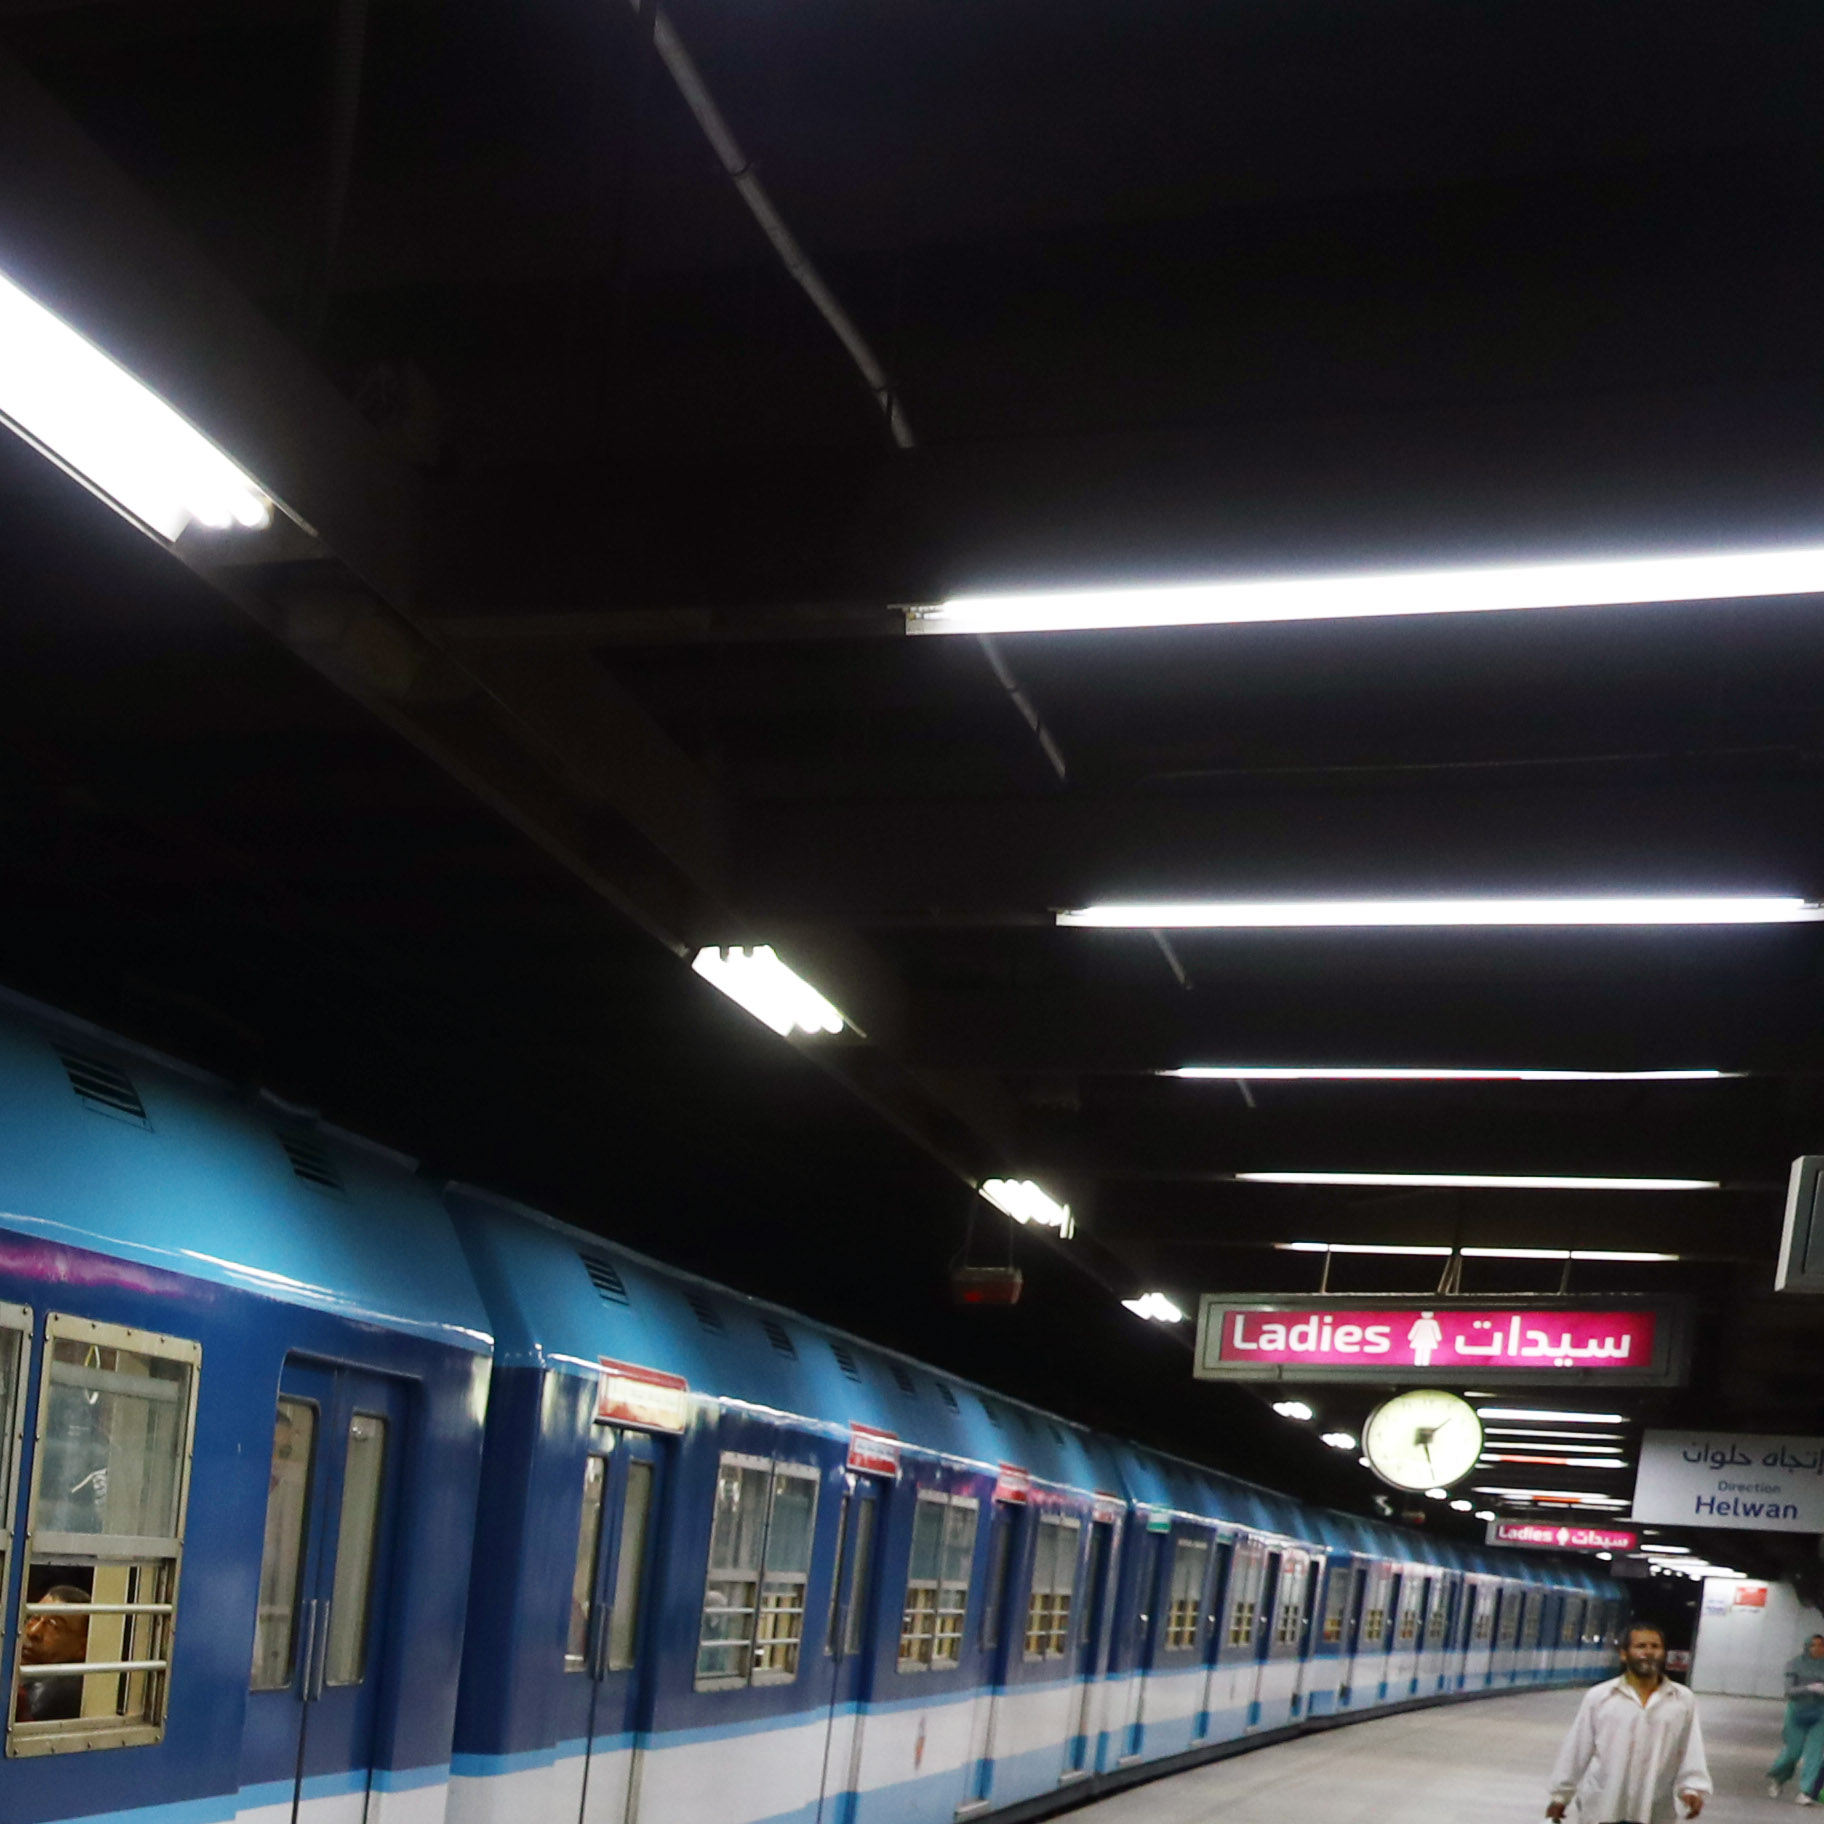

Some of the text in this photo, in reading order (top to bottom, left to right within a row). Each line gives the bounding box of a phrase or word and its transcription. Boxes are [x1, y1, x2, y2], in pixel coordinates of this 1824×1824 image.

[1232, 1314, 1632, 1368] Ladies سيدات
[1682, 1440, 1752, 1470] حلوان
[1717, 1480, 1781, 1494] Direction
[1695, 1495, 1798, 1521] Helwan
[1498, 1526, 1629, 1549] Ladies سيدات
